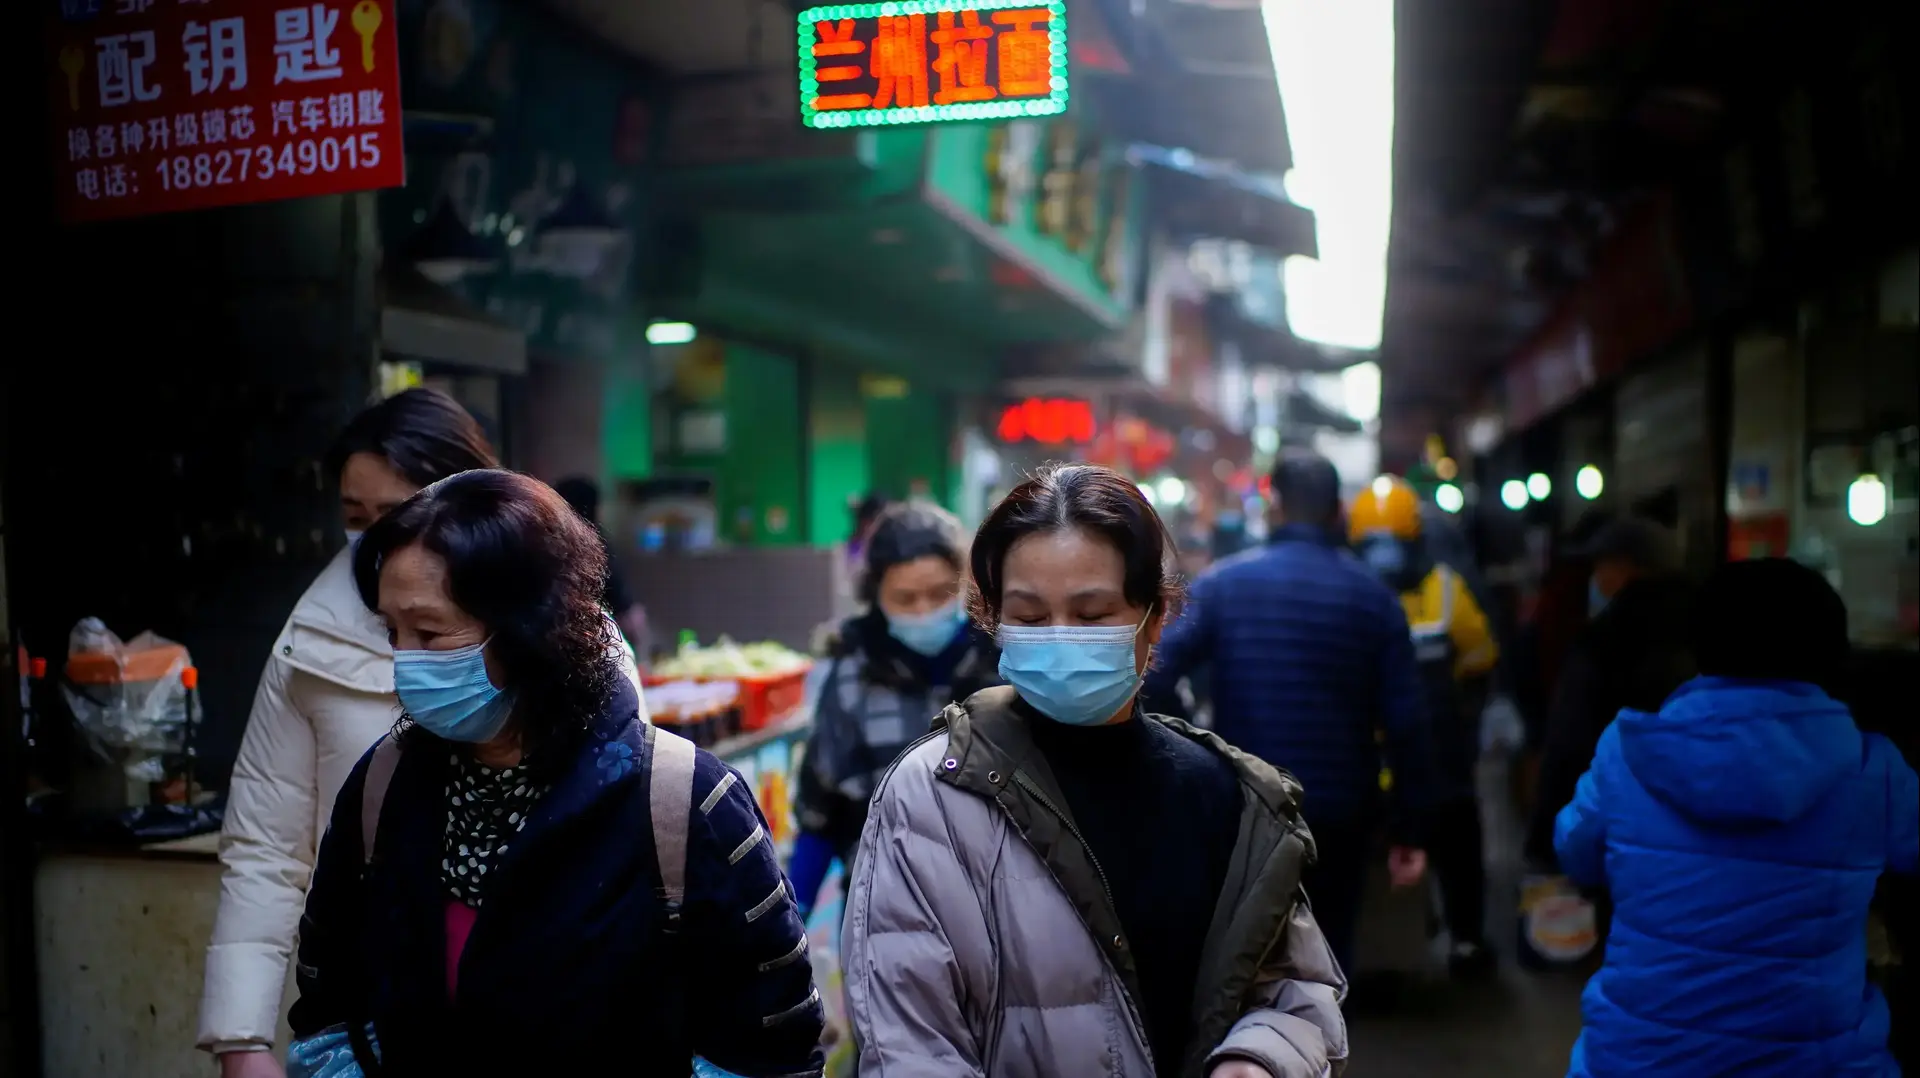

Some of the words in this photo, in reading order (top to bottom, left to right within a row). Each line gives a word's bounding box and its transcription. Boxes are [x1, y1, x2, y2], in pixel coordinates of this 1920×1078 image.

[95, 3, 343, 107] 配钥匙
[811, 9, 1052, 110] 兰州拉面
[68, 104, 256, 162] 换各种升级锁芯
[270, 88, 386, 137] 汽车钥匙
[156, 131, 381, 191] 18827349015
